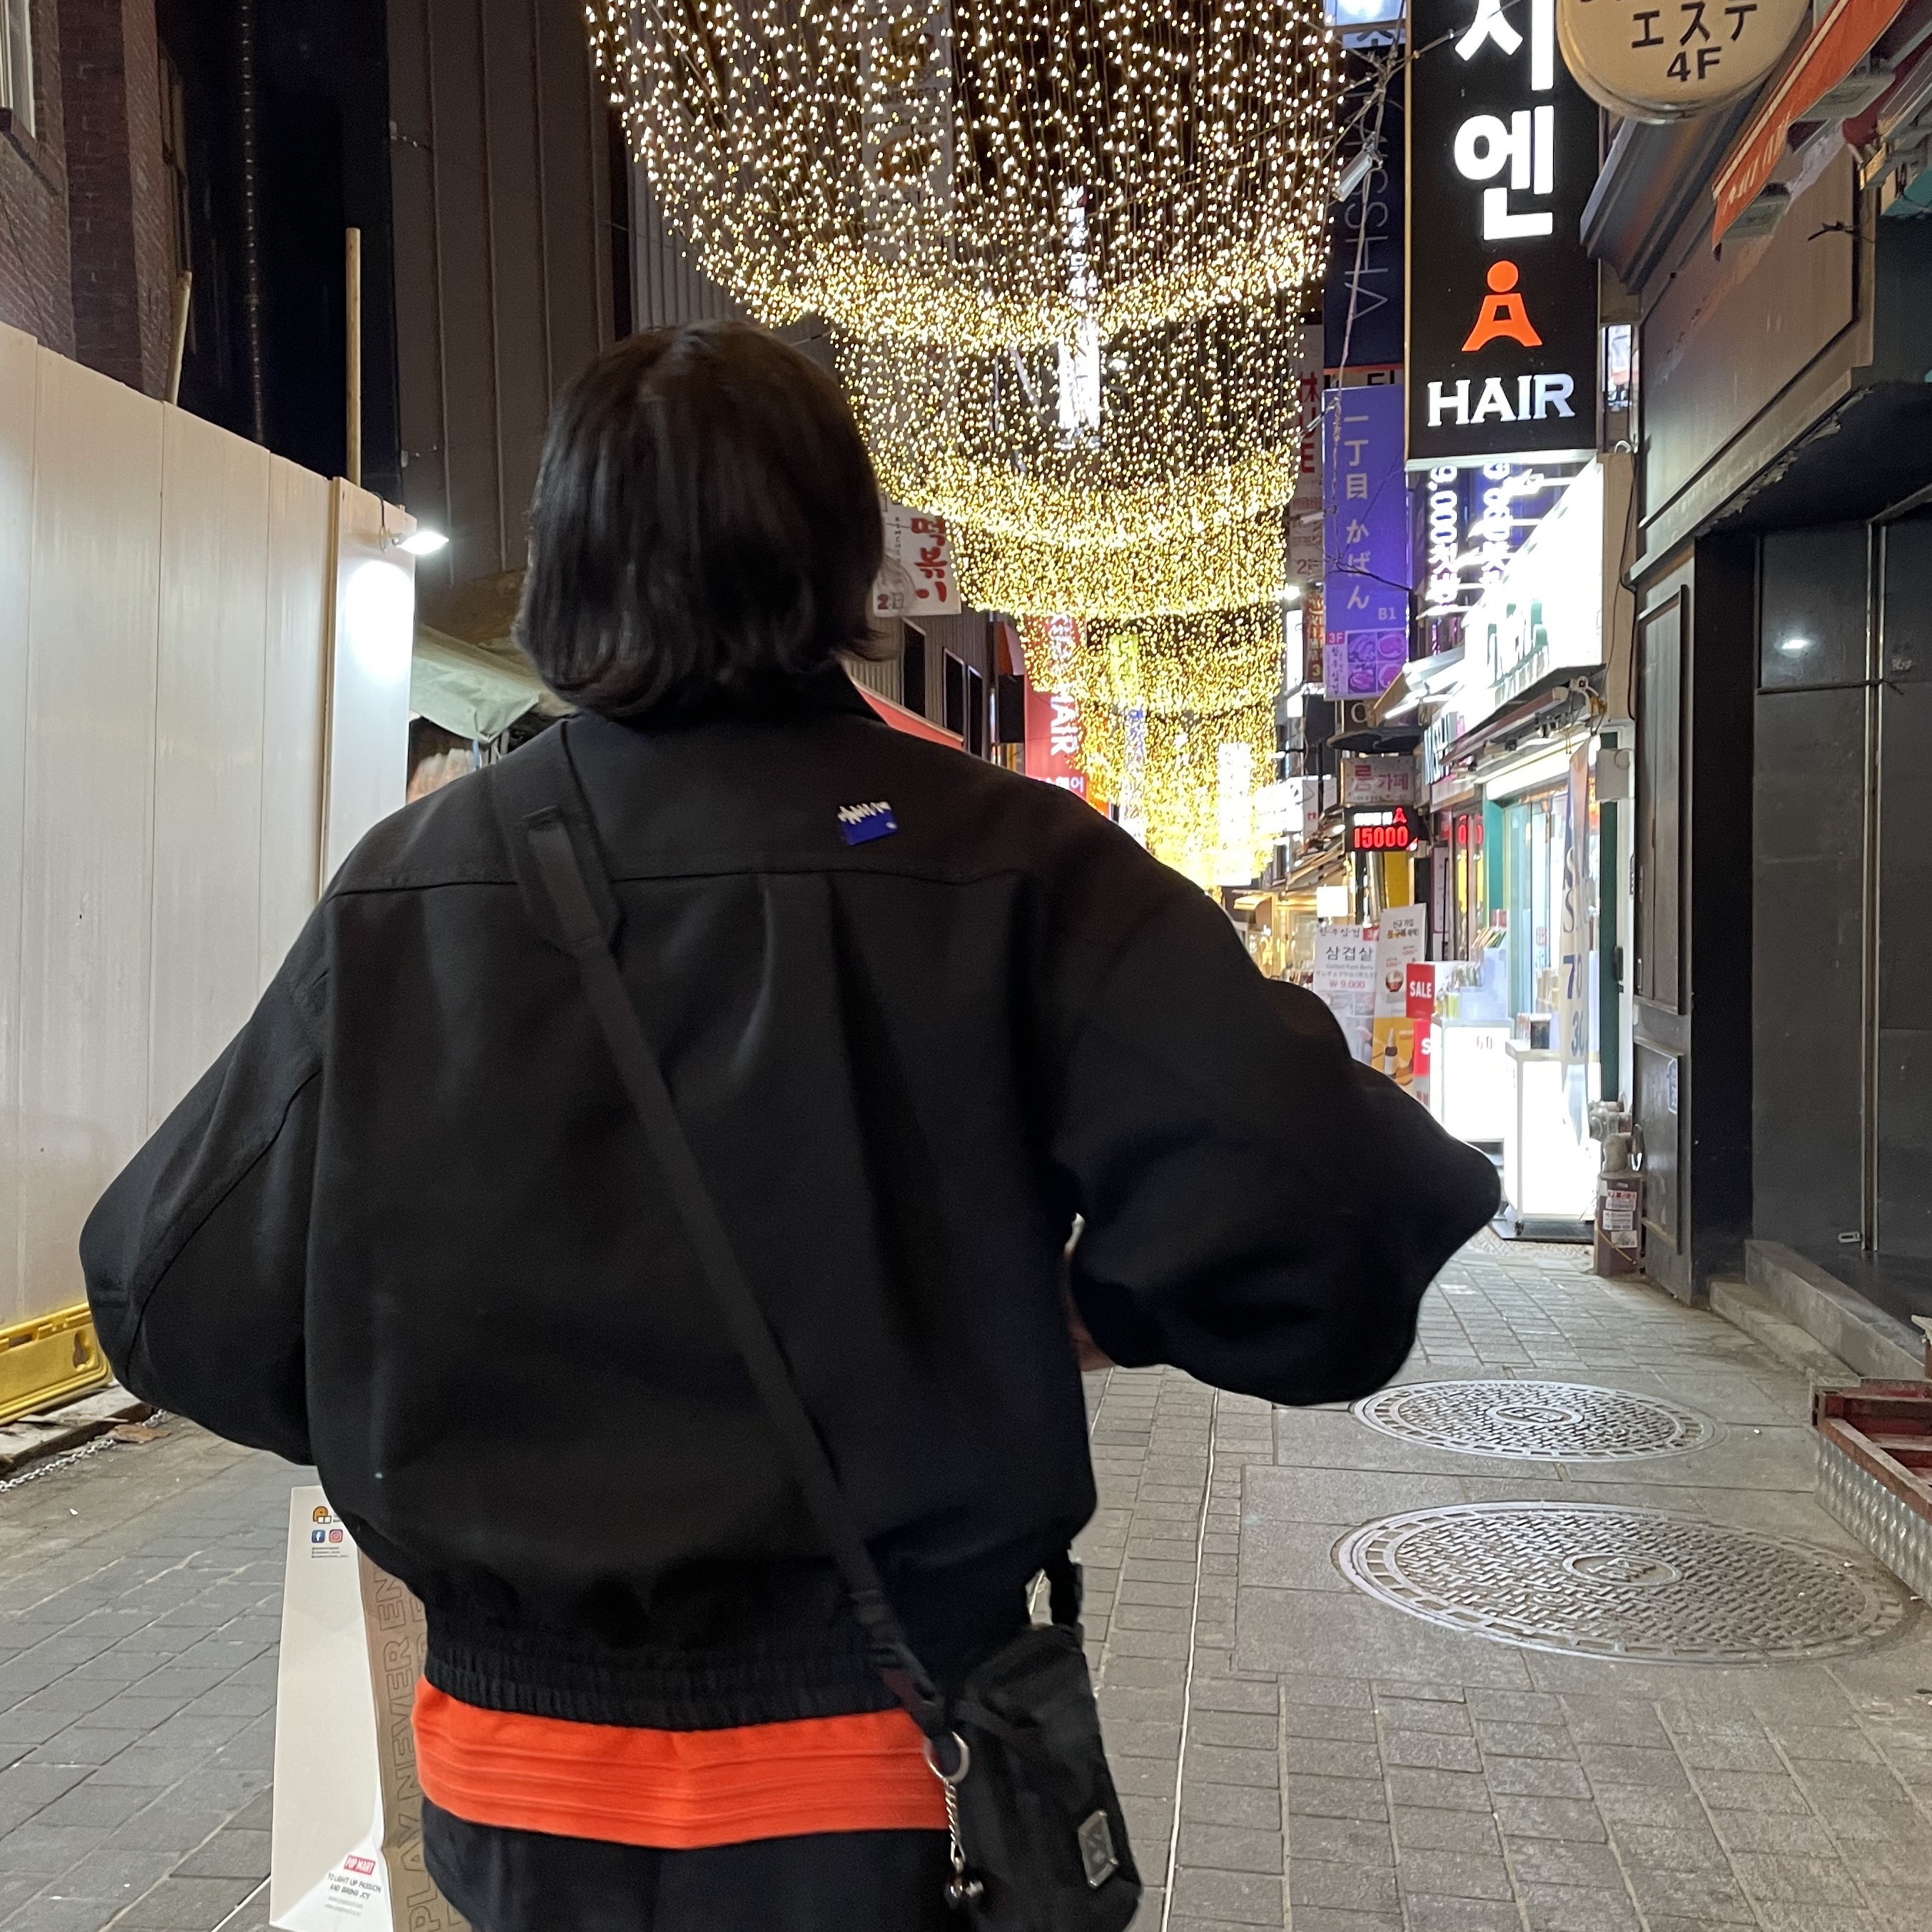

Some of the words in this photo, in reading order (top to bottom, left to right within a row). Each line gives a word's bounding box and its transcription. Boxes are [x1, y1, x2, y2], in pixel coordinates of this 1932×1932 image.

[1632, 1, 1757, 49] エステ
[1667, 46, 1721, 82] 4F
[1427, 373, 1576, 428] HAIR
[1378, 607, 1397, 621] B1
[1328, 632, 1343, 644] 3F
[1354, 826, 1408, 848] 15000
[1326, 946, 1373, 961] 삼겹살
[1410, 981, 1432, 998] SALE
[383, 1639, 421, 1802] NEVER
[399, 1811, 442, 1932] PLAY
